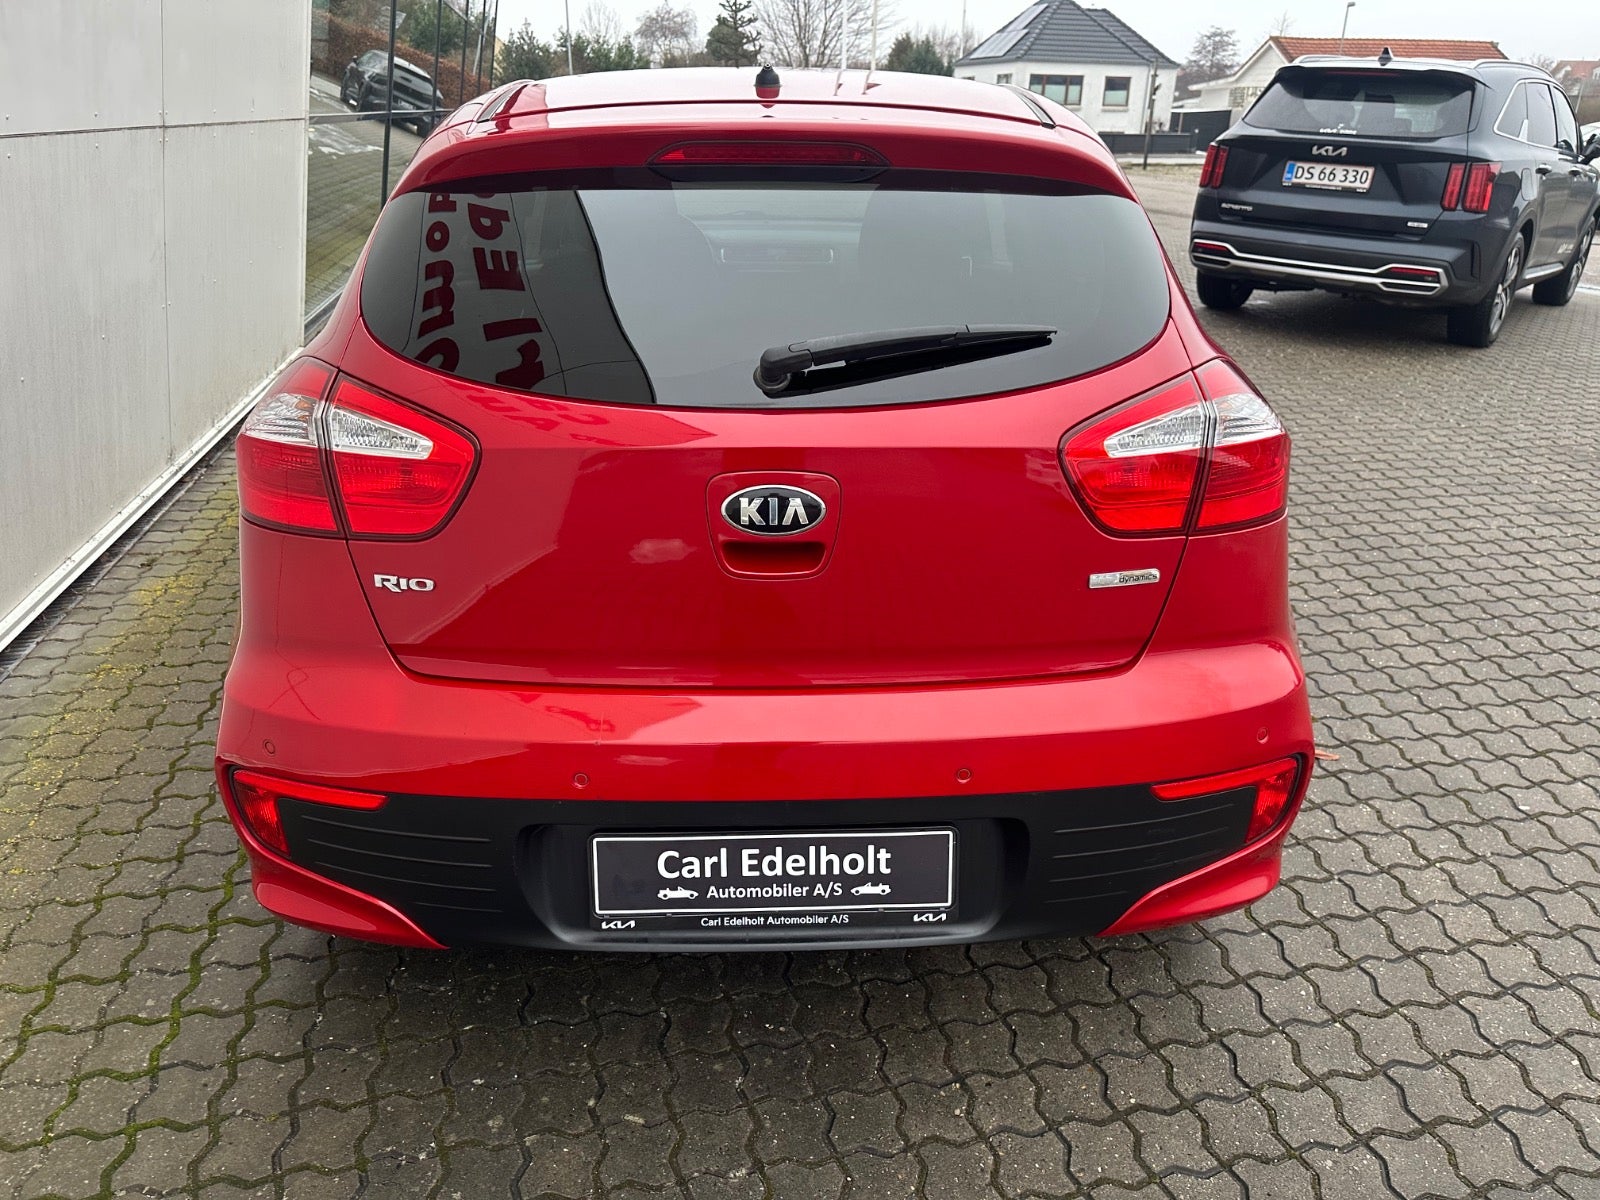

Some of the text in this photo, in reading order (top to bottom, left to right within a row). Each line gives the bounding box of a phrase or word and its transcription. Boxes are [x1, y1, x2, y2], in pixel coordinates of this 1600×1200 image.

[1312, 145, 1347, 156] KIA
[1295, 166, 1315, 180] DS
[1318, 167, 1336, 182] 66
[1339, 169, 1369, 185] 330
[739, 497, 809, 526] KIA
[374, 574, 434, 592] RIO
[1119, 573, 1158, 584] dynamics
[657, 845, 891, 879] Carl Edelholt
[706, 881, 843, 898] Automobiler A/S
[601, 920, 636, 930] KIA
[701, 914, 849, 927] Carl Edelholt Automobiler A/S
[913, 913, 948, 922] KIA
